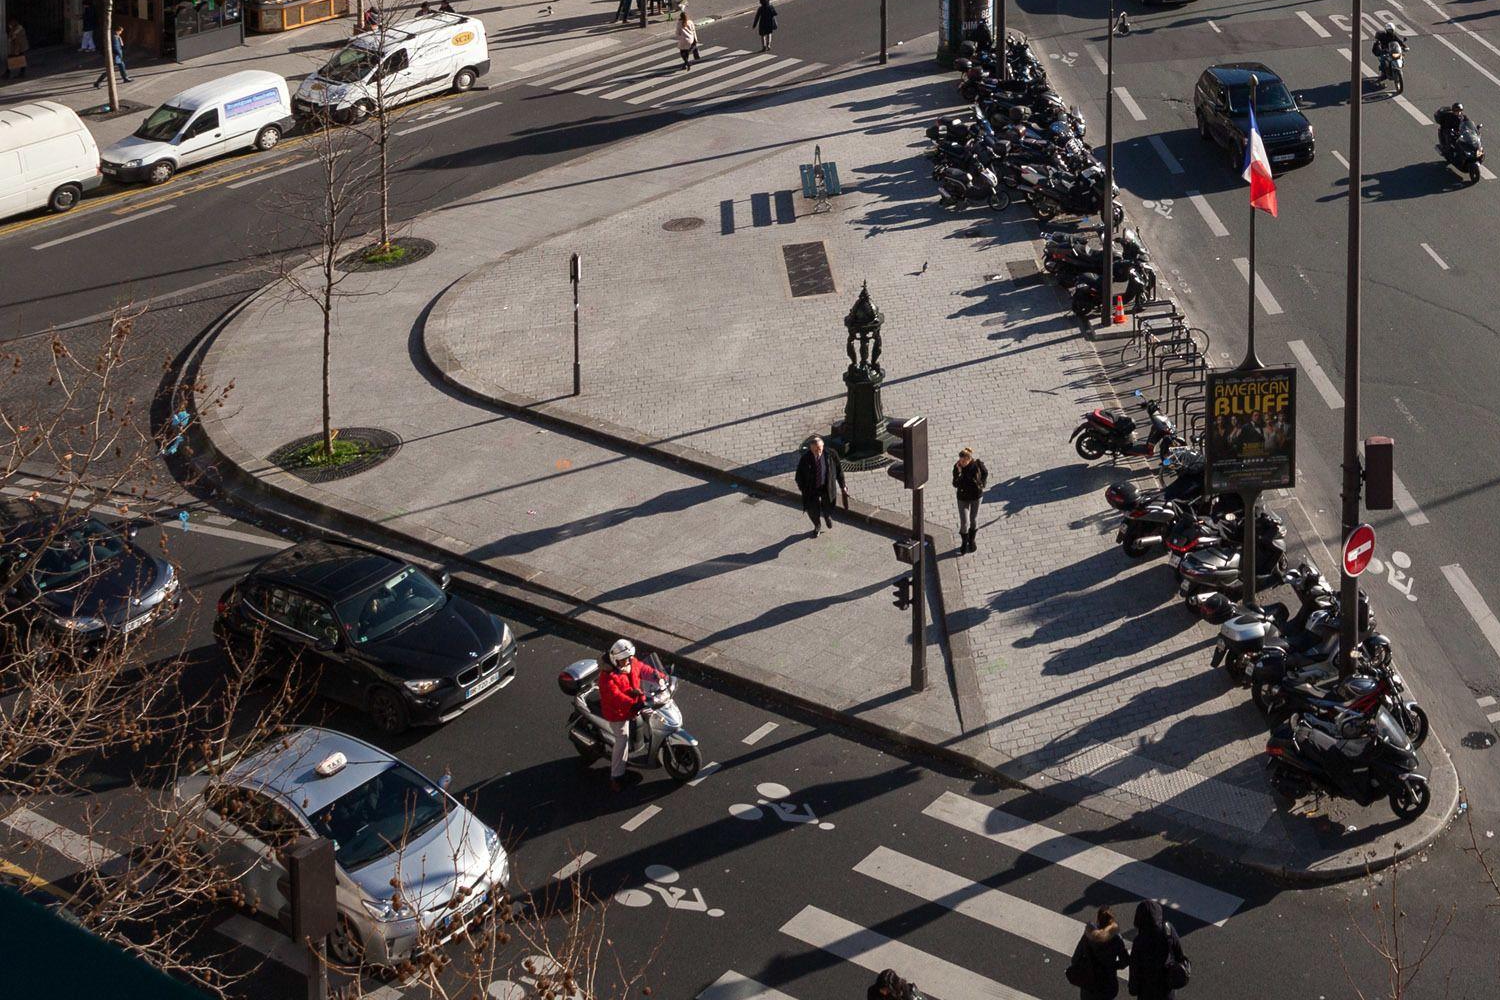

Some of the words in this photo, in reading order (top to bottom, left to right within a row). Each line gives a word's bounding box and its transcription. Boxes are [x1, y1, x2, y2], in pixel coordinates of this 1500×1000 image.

[1215, 380, 1290, 397] AMERICAN
[1214, 393, 1290, 417] BLUFF
[326, 757, 343, 770] TAXI
